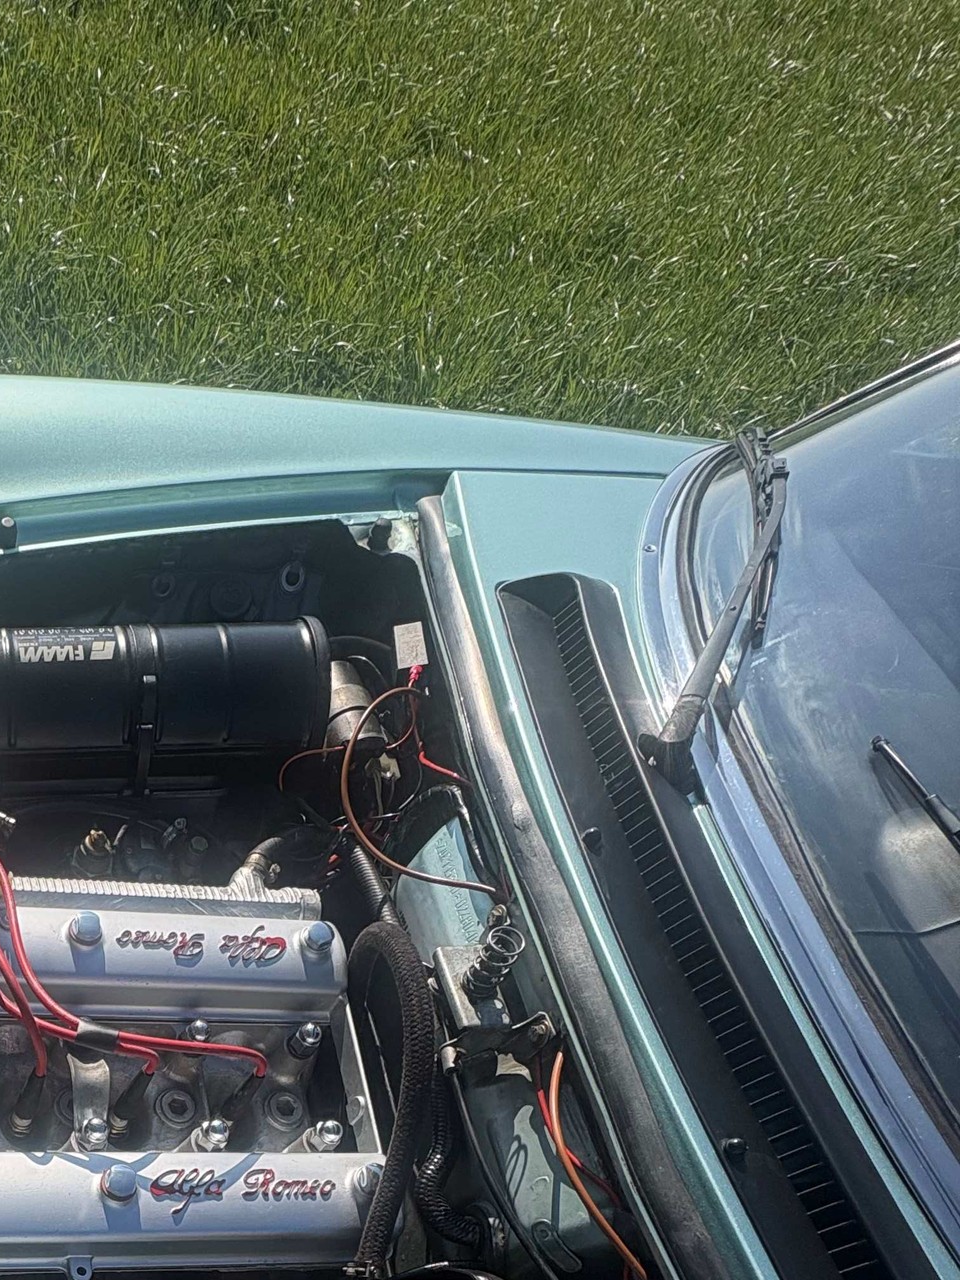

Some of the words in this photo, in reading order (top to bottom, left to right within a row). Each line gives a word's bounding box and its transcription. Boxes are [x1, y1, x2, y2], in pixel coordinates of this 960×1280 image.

[19, 645, 85, 662] FIAAM
[116, 930, 205, 969] Romeo
[218, 926, 287, 968] Alfa
[149, 1168, 226, 1215] Alfa
[241, 1168, 336, 1200] Romeo
